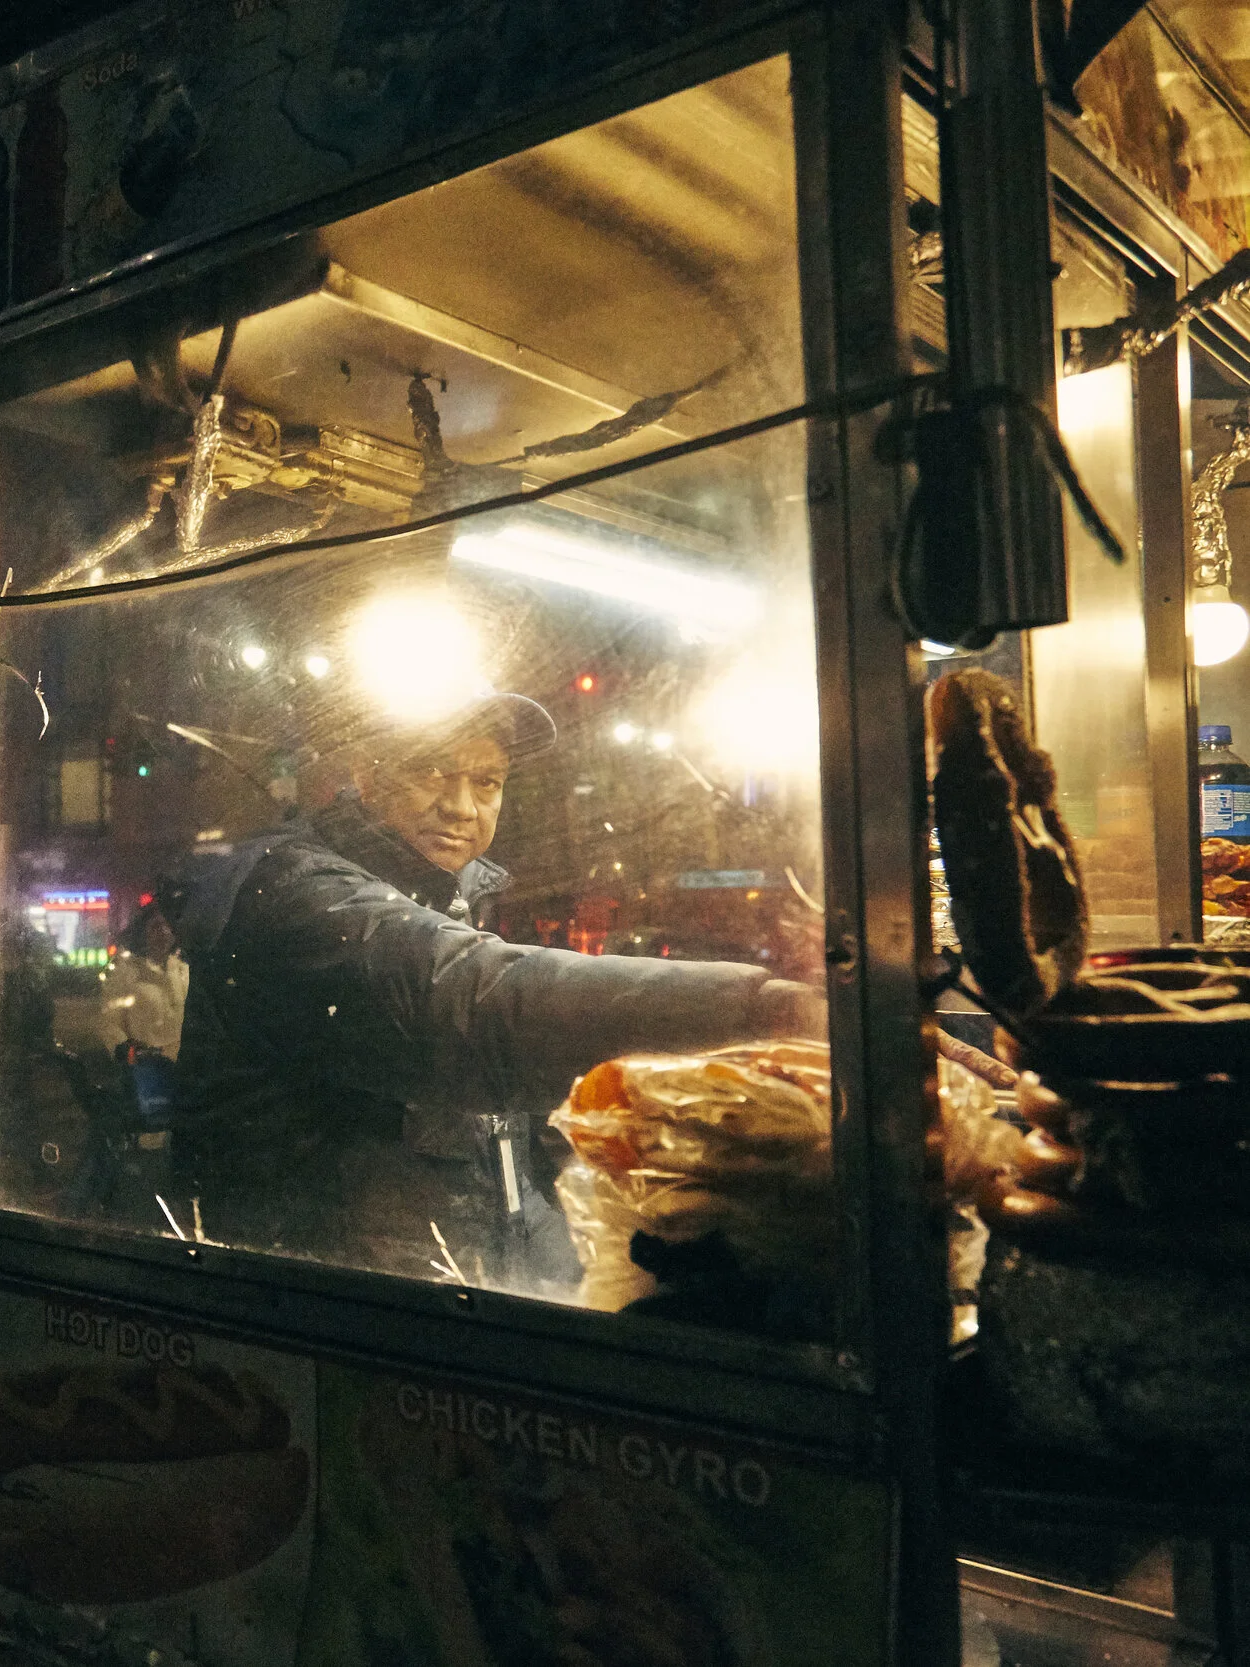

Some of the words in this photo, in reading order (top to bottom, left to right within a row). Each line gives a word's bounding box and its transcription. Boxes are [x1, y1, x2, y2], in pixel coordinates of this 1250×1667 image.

[46, 1304, 110, 1350] HOT
[118, 1319, 196, 1367] DOG
[396, 1382, 599, 1466] CHICKEN
[617, 1431, 771, 1507] GYRO
